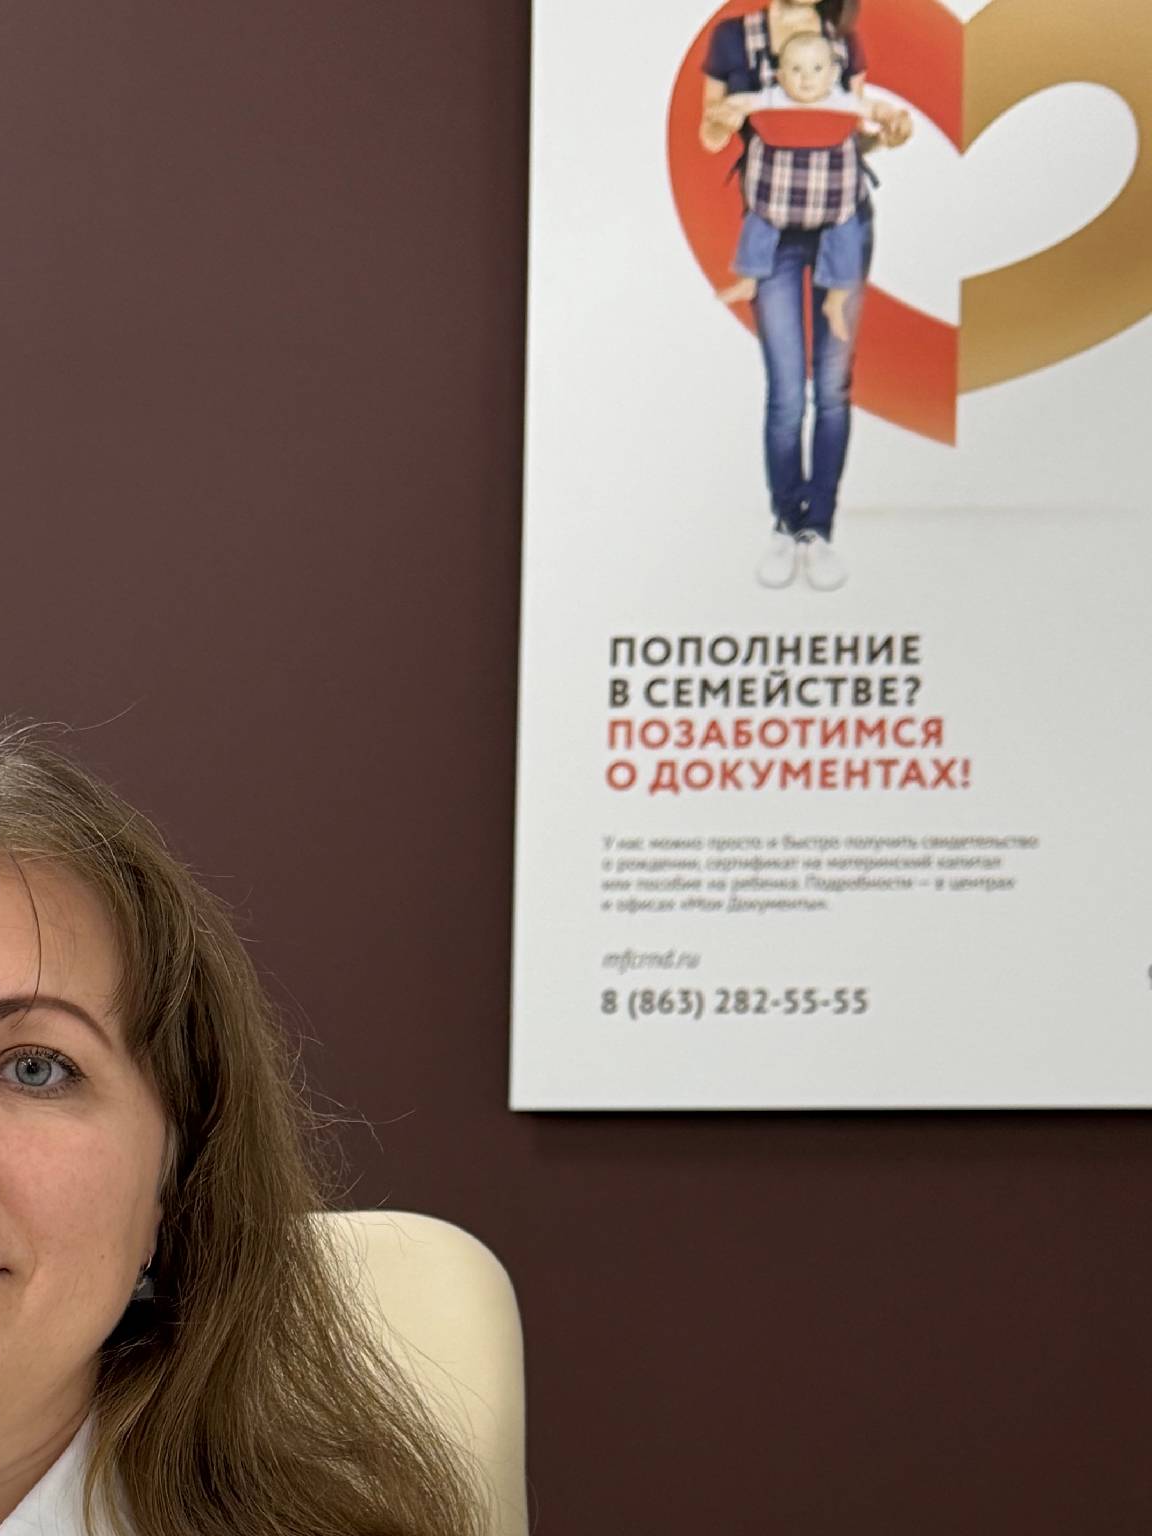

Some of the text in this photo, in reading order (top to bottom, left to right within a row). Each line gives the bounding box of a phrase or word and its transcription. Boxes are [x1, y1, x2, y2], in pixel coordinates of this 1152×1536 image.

[609, 636, 921, 667] ПОПОЛНЕНИЕ
[609, 671, 921, 708] В СЕМЕЙСТВЕ?
[607, 717, 945, 749] ПОЗАБОТИМСЯ
[606, 758, 971, 795] О ДОКУМЕНТАХ!
[601, 987, 868, 1019] 8 (863) 282-55-55
